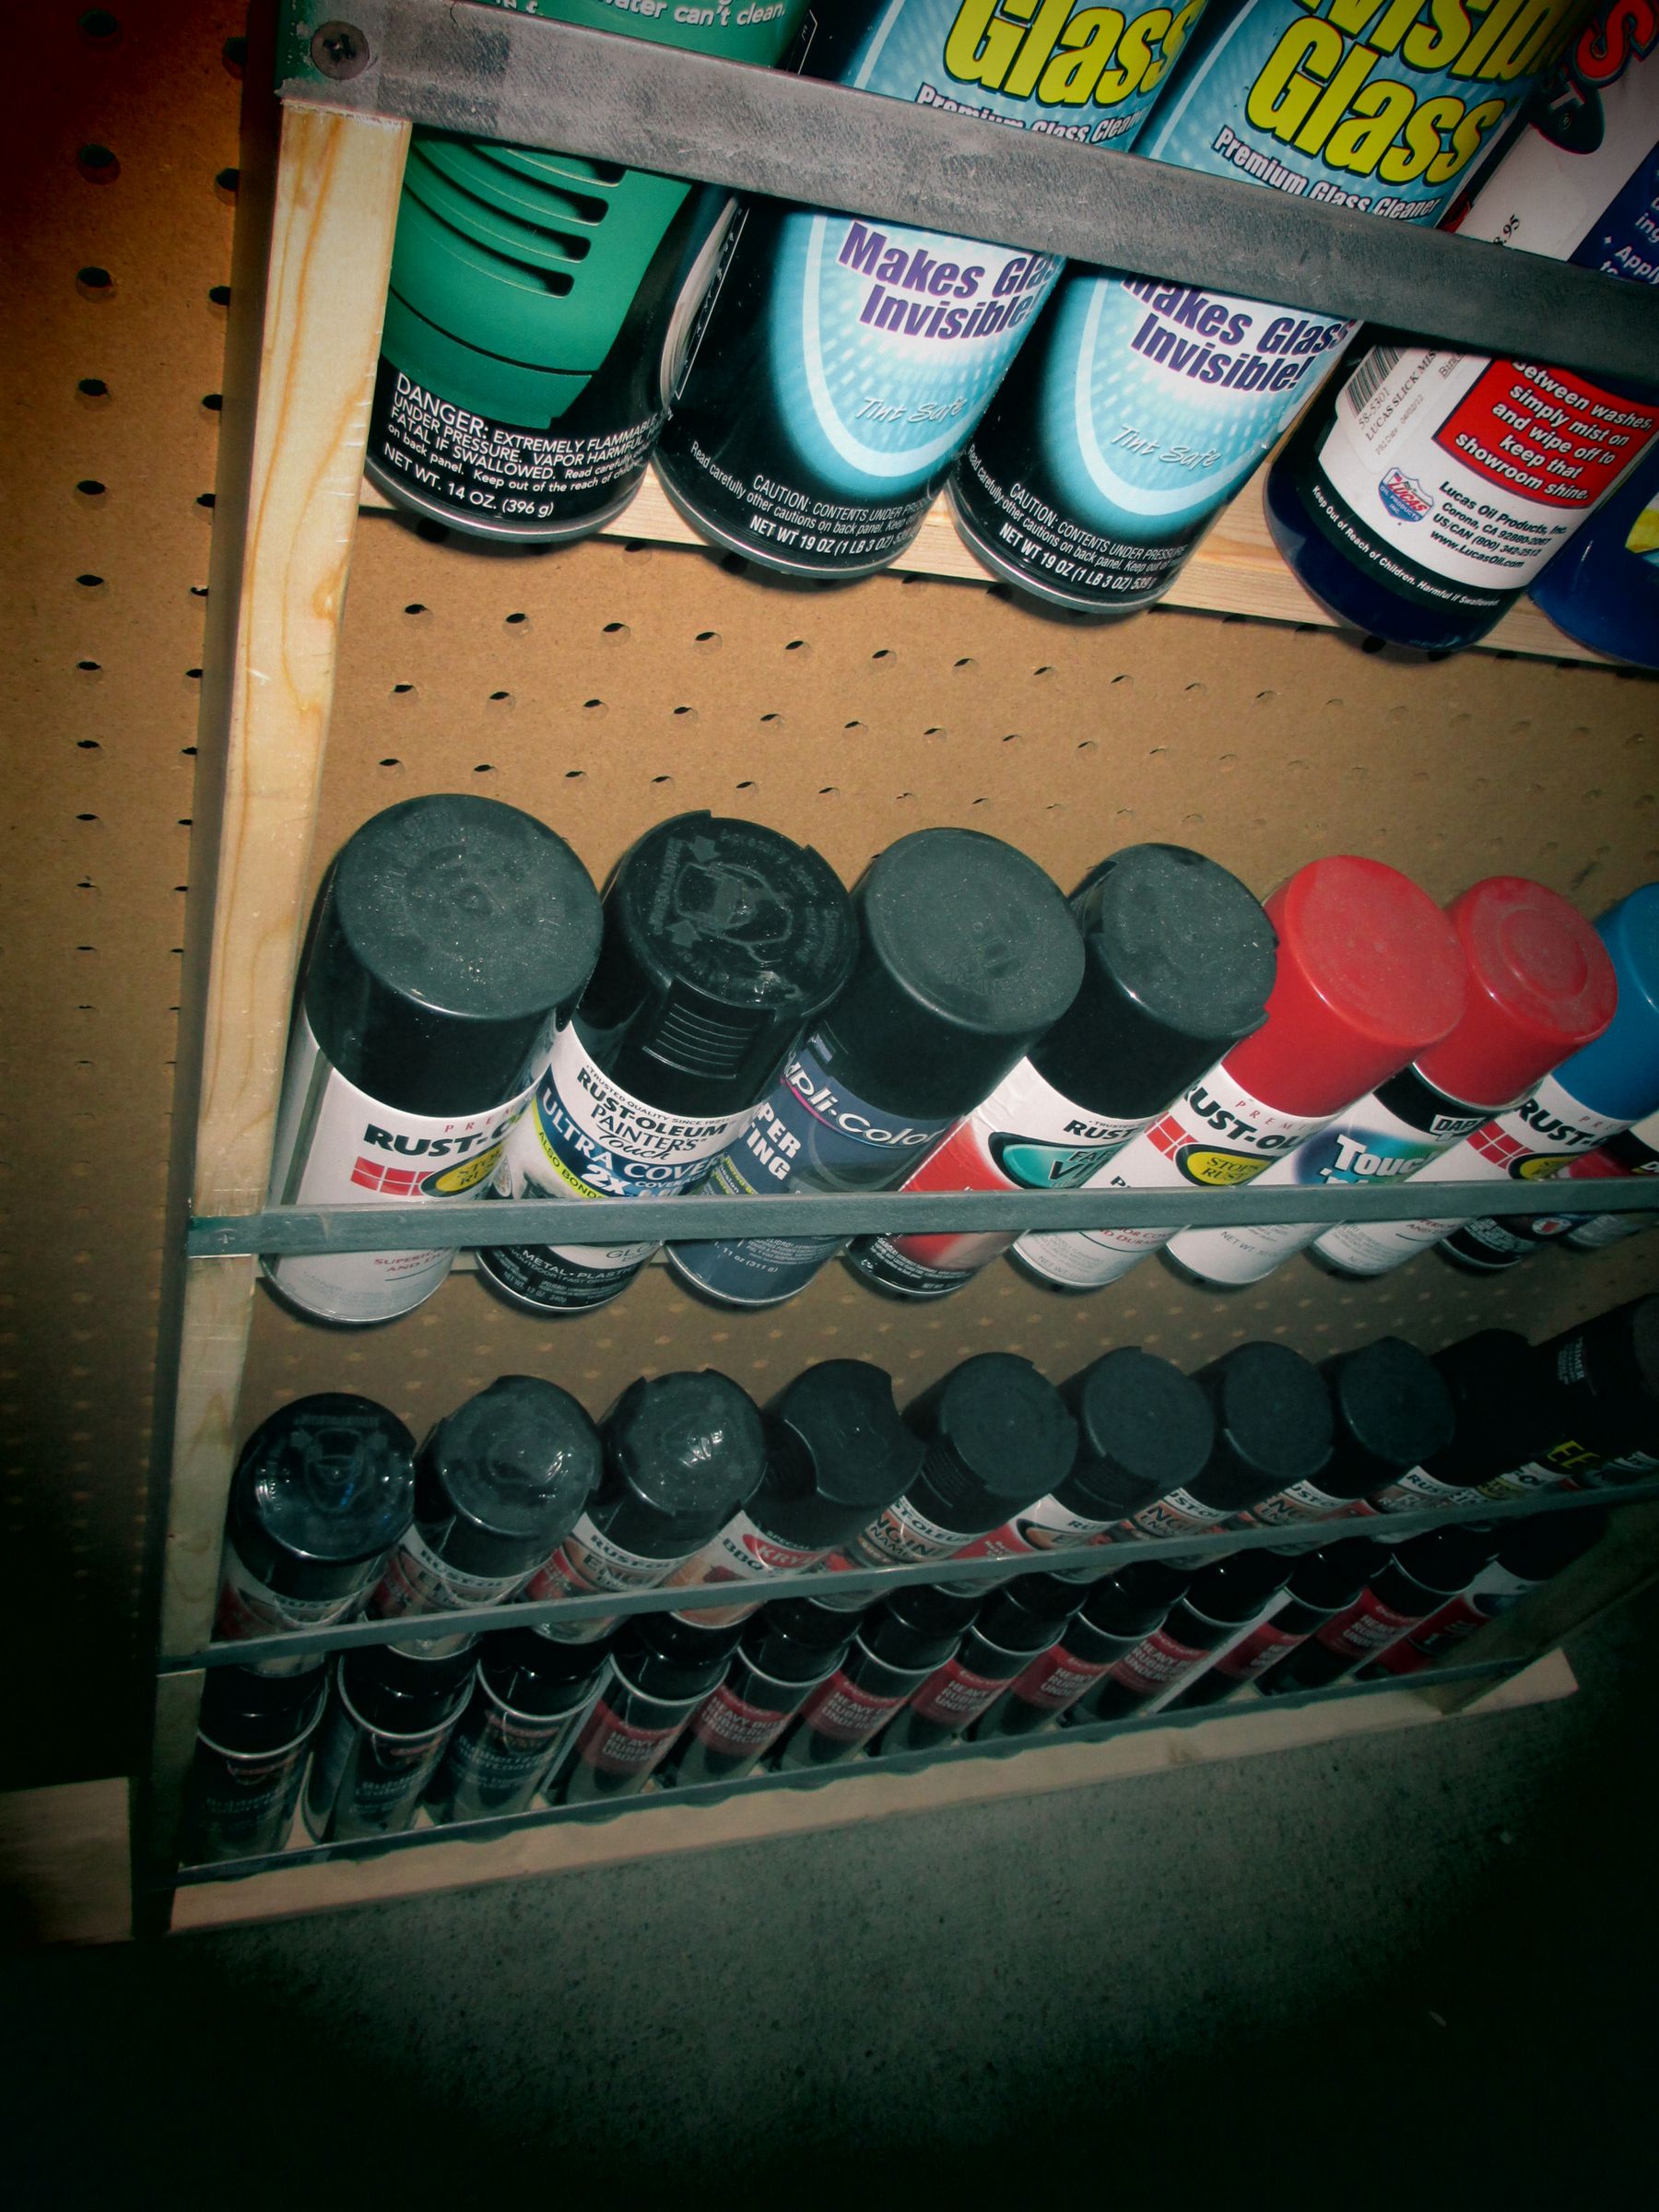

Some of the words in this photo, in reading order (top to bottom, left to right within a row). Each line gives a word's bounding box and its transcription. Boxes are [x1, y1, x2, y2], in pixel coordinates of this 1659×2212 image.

[673, 3, 733, 27] can't
[1247, 16, 1507, 184] Glass
[1214, 127, 1309, 196] Premium
[1372, 196, 1443, 219] Cleaner
[838, 221, 985, 299] Makes
[1130, 312, 1317, 392] Invisible!
[1256, 317, 1356, 356] Glass
[396, 372, 489, 440] DANGER:
[493, 429, 584, 453] EXTREMELY
[855, 397, 902, 423] Tint
[908, 397, 968, 423] Safe
[1365, 405, 1394, 441] LUCAS
[1392, 371, 1419, 406] SLICK
[1418, 350, 1437, 374] MIS
[1509, 383, 1570, 429] simply
[1569, 419, 1610, 442] mist
[1608, 433, 1630, 447] on
[1590, 404, 1653, 432] washes,
[388, 424, 400, 438] on
[403, 433, 428, 457] back
[429, 453, 465, 476] panel.
[473, 469, 504, 488] Keep
[509, 481, 529, 491] out
[533, 482, 546, 492] of
[548, 481, 567, 492] the
[570, 476, 598, 491] reach
[601, 472, 612, 484] of
[391, 406, 431, 445] FATAL
[435, 437, 450, 452] IF
[453, 446, 556, 480] SWALLOWED.
[564, 466, 593, 479] Read
[394, 393, 441, 434] UNDER
[443, 426, 523, 463] PRESSURE.
[533, 453, 585, 466] VAPOR
[1112, 424, 1159, 456] Tint
[1159, 444, 1224, 470] Safe
[1491, 402, 1533, 431] and
[1528, 426, 1572, 455] wipe
[1573, 446, 1604, 462] off
[1599, 450, 1617, 465] to
[1499, 434, 1547, 468] keep
[1546, 458, 1584, 480] that
[384, 442, 413, 471] NET
[415, 464, 441, 490] WT.
[448, 483, 465, 500] 14
[469, 490, 497, 510] OZ.
[501, 499, 535, 514] (396
[537, 501, 555, 518] g)
[690, 441, 711, 468] Read
[709, 464, 747, 500] carefully
[747, 491, 774, 512] other
[774, 506, 817, 529] cautions
[818, 521, 830, 532] on
[832, 523, 855, 535] back
[1454, 432, 1545, 490] showroom
[1544, 482, 1590, 500] shine.
[753, 475, 812, 512] CAUTION:
[813, 502, 869, 522] CONTENTS
[968, 444, 982, 471] Read
[977, 467, 1005, 505] carefully
[1002, 499, 1025, 523] other
[1022, 517, 1060, 547] cautions
[1060, 541, 1074, 554] on
[1073, 547, 1098, 563] back
[1094, 556, 1124, 571] panel.
[1009, 482, 1059, 529] CAUTION:
[1057, 522, 1111, 552] CONTENTS
[1110, 543, 1144, 559] UNDER
[1388, 481, 1428, 512] LUCAS
[1390, 494, 1419, 521] PRODUCTS
[1439, 480, 1477, 510] Lucas
[1477, 504, 1499, 520] Oil
[1496, 512, 1548, 535] Products,
[1441, 501, 1480, 530] Corona,
[1482, 524, 1499, 535] CA
[749, 515, 777, 536] NET
[776, 526, 800, 545] WT
[800, 535, 817, 550] 19
[816, 537, 836, 553] OZ
[834, 540, 849, 557] (1
[849, 539, 866, 554] LB
[865, 539, 875, 552] 3
[876, 536, 894, 551] OZ)
[999, 523, 1024, 547] NET
[1021, 538, 1042, 559] WT
[1040, 552, 1056, 569] 19
[1054, 559, 1076, 577] OZ
[1071, 567, 1085, 582] (1
[1085, 571, 1104, 586] LB
[1102, 576, 1112, 589] 3
[1111, 576, 1133, 592] OZ)
[1312, 485, 1327, 508] Keep
[1326, 505, 1340, 523] Out
[1337, 519, 1348, 530] of
[1345, 528, 1371, 553] Reach
[1369, 551, 1381, 560] of
[1379, 558, 1417, 585] Children.
[1416, 581, 1453, 601] Harmful
[1430, 531, 1525, 569] www.LucasOil.com
[1432, 513, 1475, 540] US/CAN
[1472, 535, 1500, 552] (800)
[576, 1066, 728, 1137] RUST-OLEUM
[590, 1068, 626, 1101] TRUSTED
[627, 1100, 669, 1121] QUALITY
[539, 1132, 560, 1167] ALSO
[542, 1088, 613, 1171] ULTRA
[1435, 1118, 1477, 1133] DAP
[581, 1163, 631, 1195] 2X
[523, 1250, 568, 1276] METAL
[723, 1537, 764, 1571] BBQ
